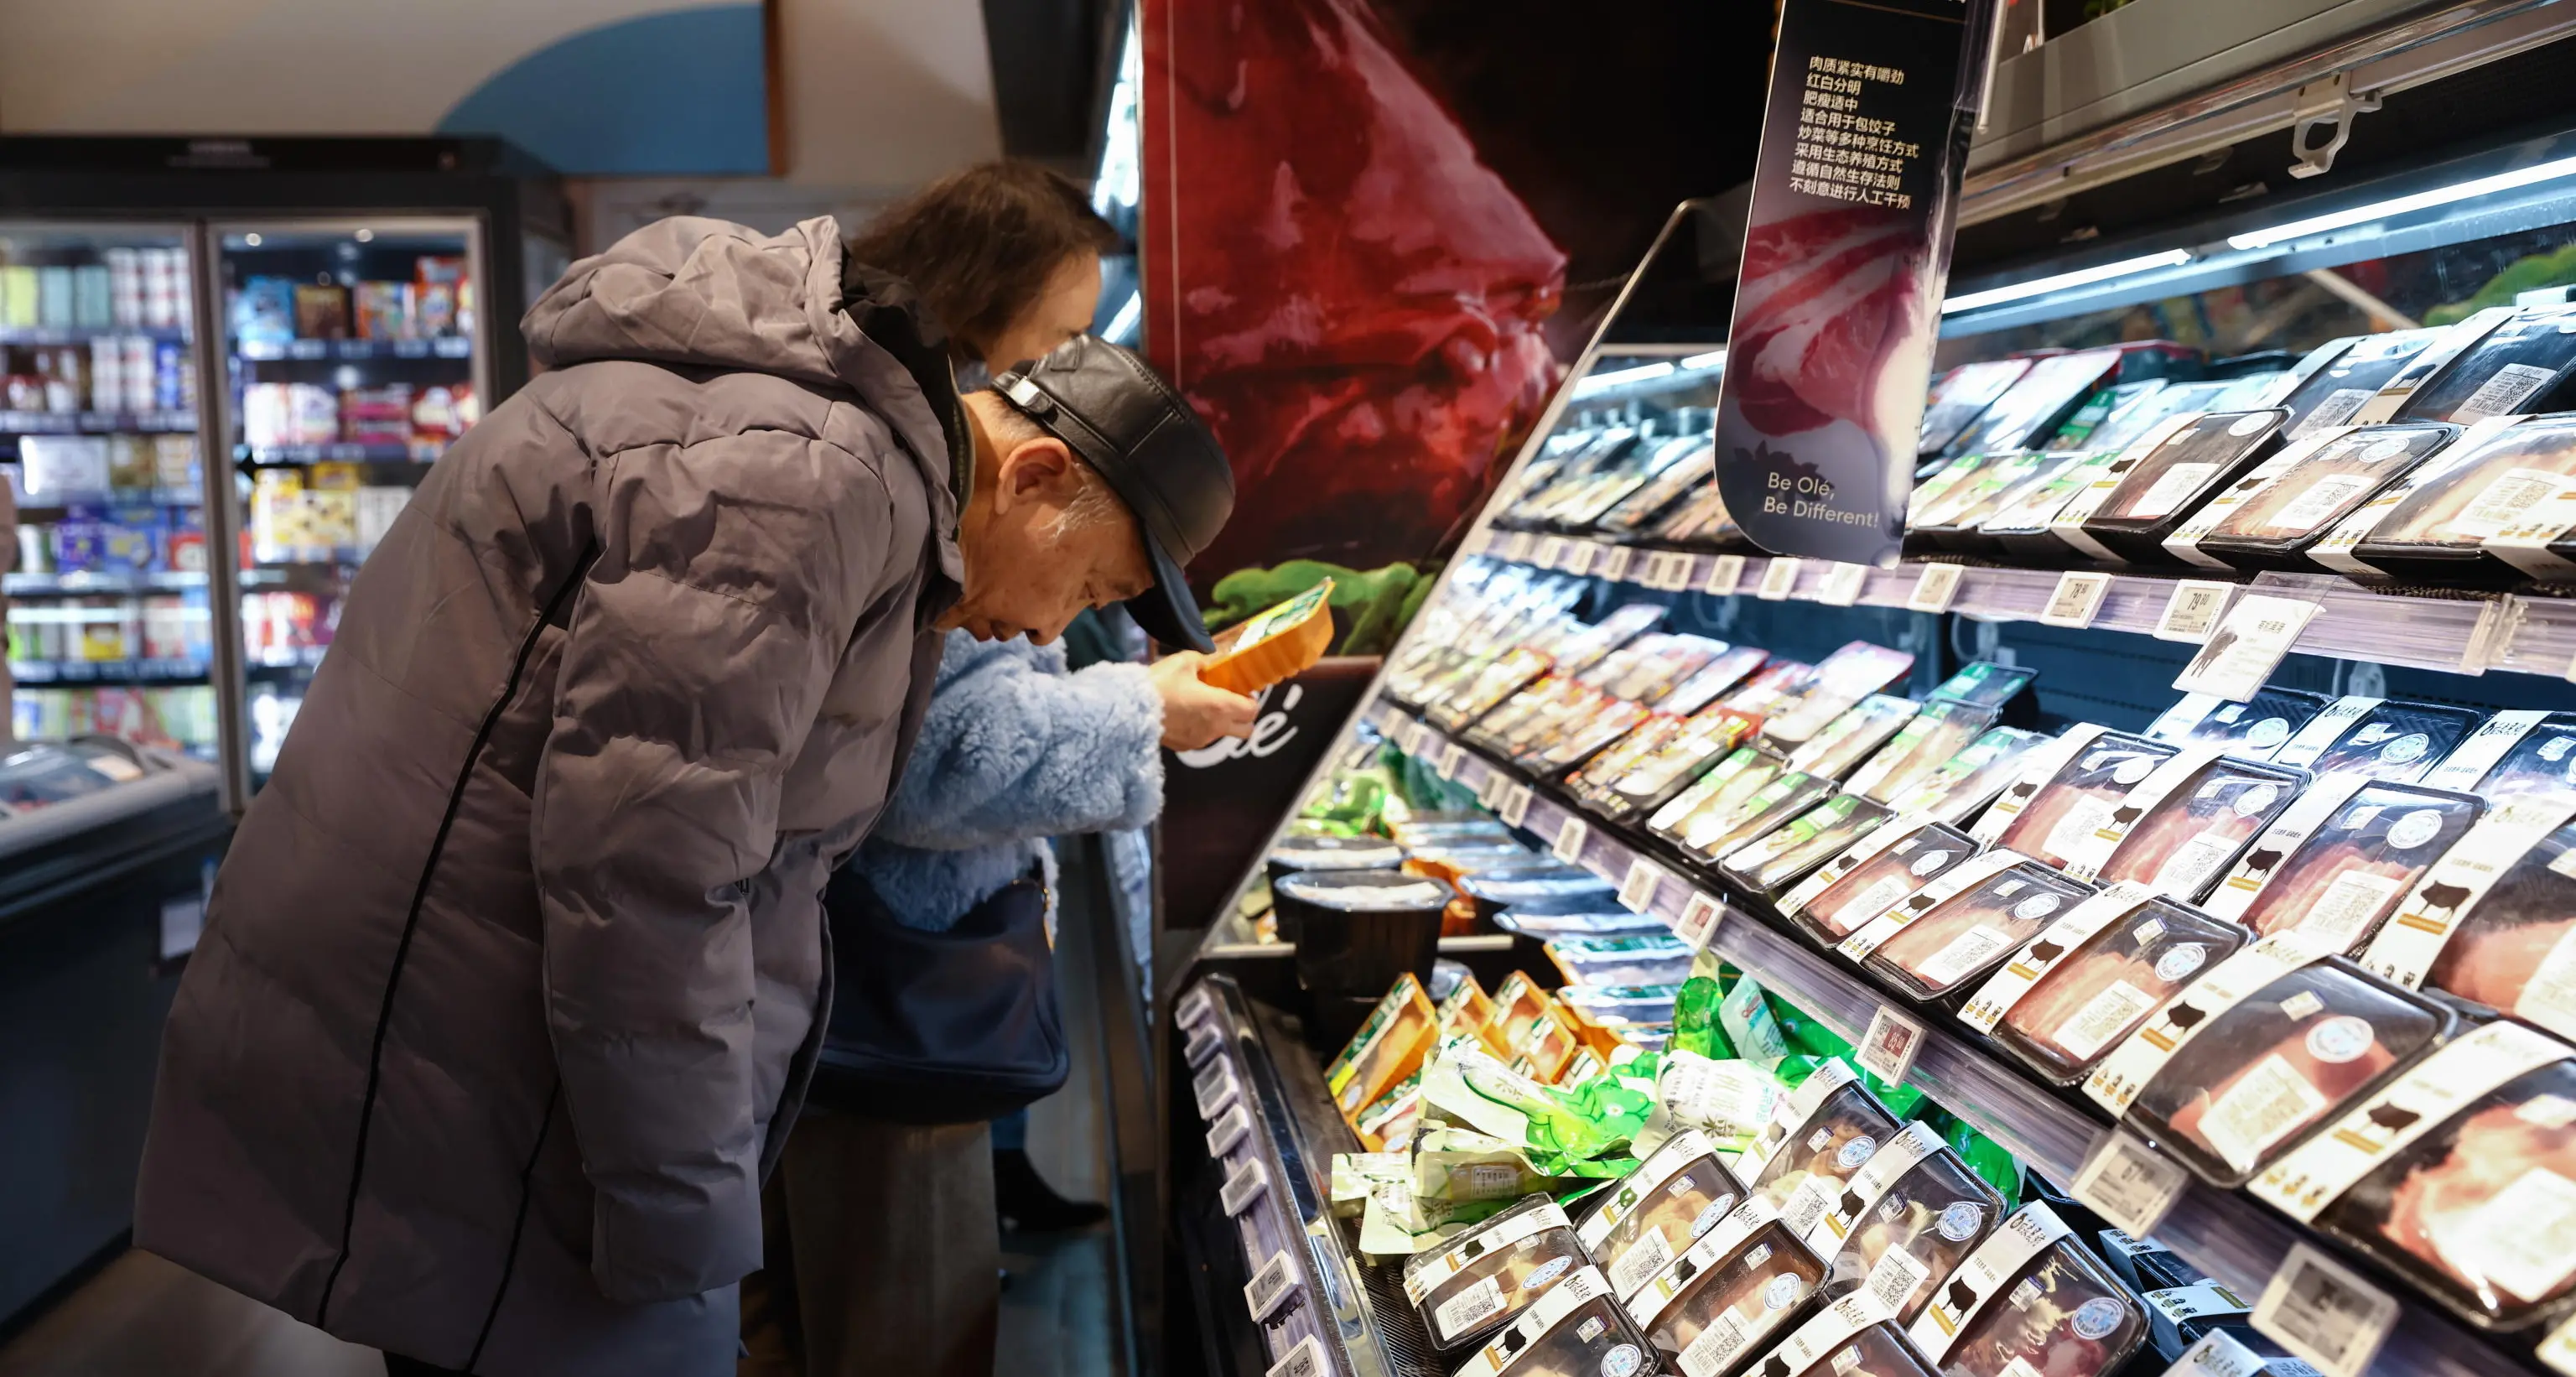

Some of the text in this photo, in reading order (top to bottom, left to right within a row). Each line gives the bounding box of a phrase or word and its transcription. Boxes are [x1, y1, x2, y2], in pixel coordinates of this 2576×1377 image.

[1806, 73, 1862, 96] 红白分明
[1810, 55, 1904, 86] 肉质紧实有嚼劲
[1803, 90, 1858, 112] 肥瘦适中
[1800, 107, 1896, 136] 适合用于包饺子
[1797, 125, 1919, 158] 炒菜等多种烹饪方式
[1794, 142, 1903, 174] 采用生态养殖方式
[1792, 159, 1901, 191] 遵循自然生存法则
[1789, 177, 1912, 210] 不刻意进行人工干预
[1768, 472, 1836, 500] Be Olé,
[1763, 496, 1879, 528] Be Different!
